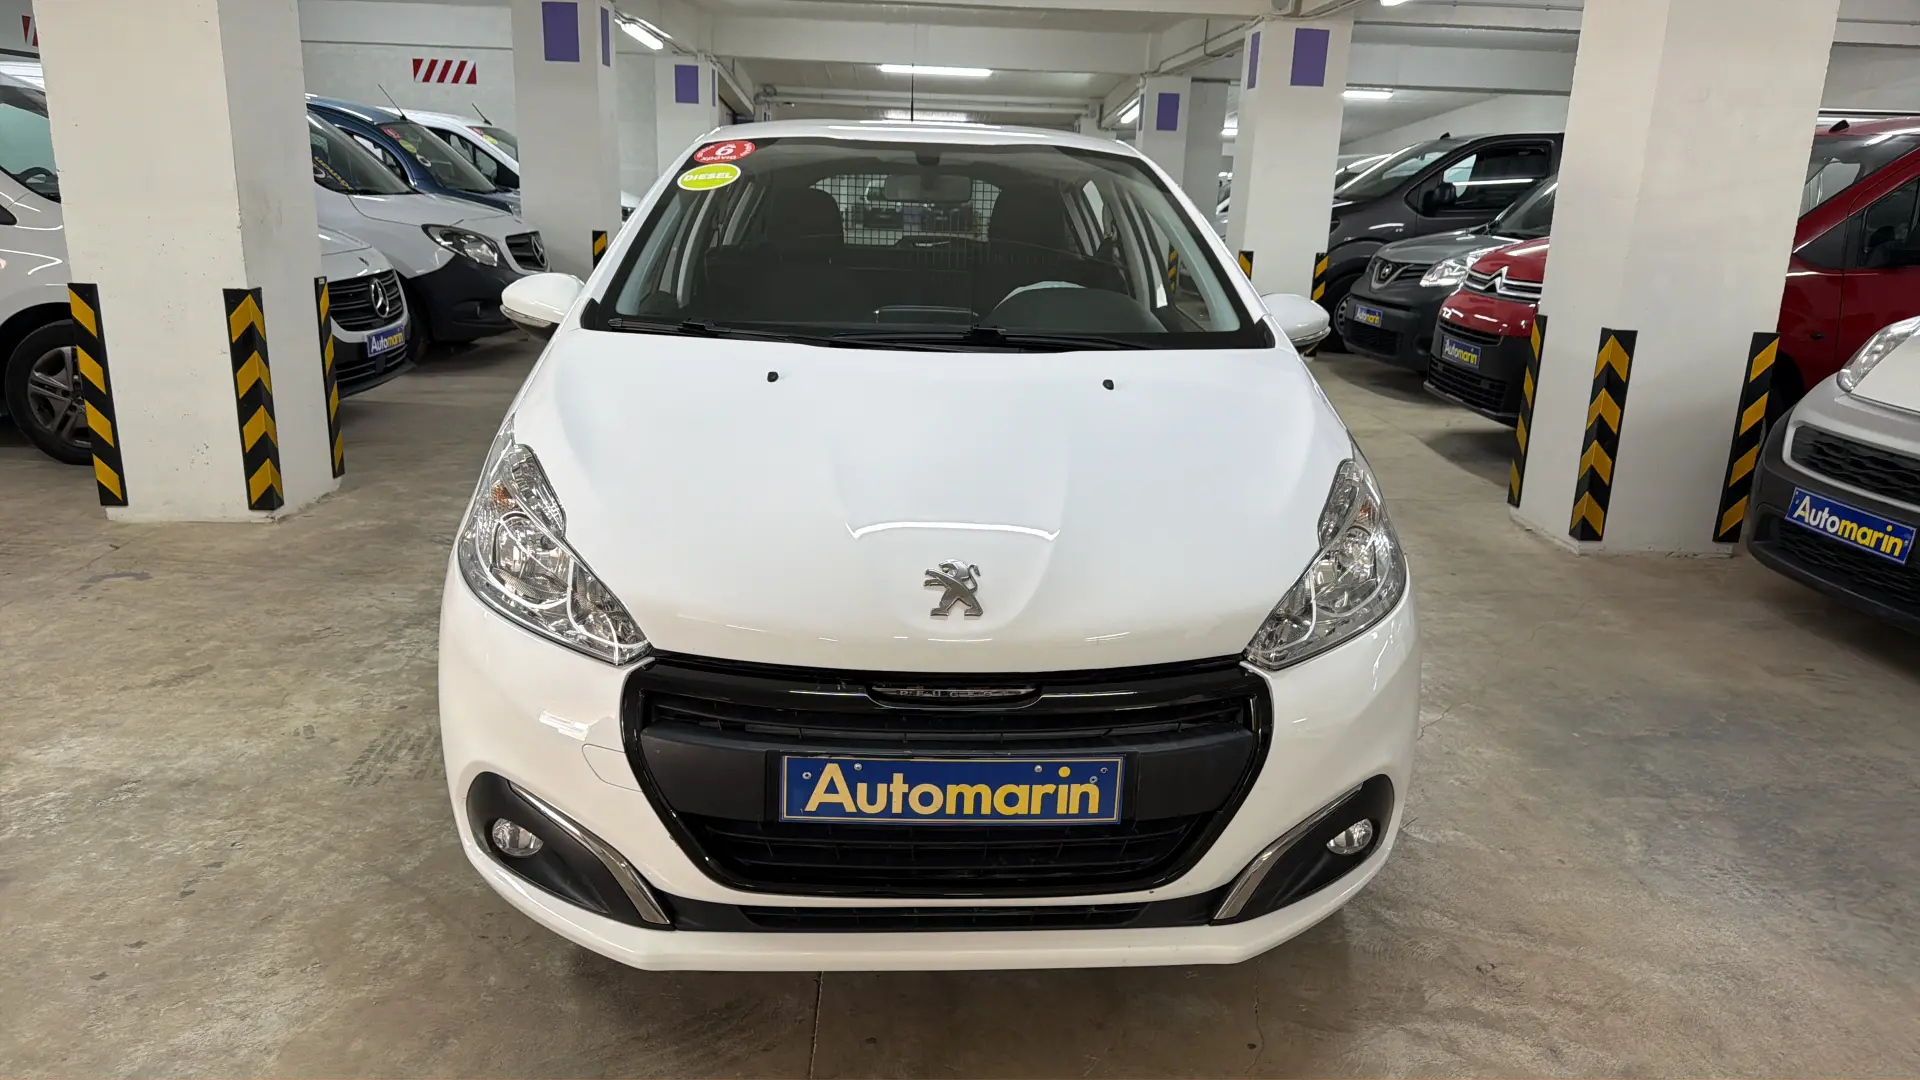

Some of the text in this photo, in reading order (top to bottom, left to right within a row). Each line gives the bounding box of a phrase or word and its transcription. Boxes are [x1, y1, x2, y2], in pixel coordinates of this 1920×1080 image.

[715, 144, 737, 156] 6
[682, 172, 733, 182] DIESEL
[371, 327, 404, 354] Automarin
[1792, 495, 1903, 557] Automarin
[804, 763, 1101, 817] Automarin
